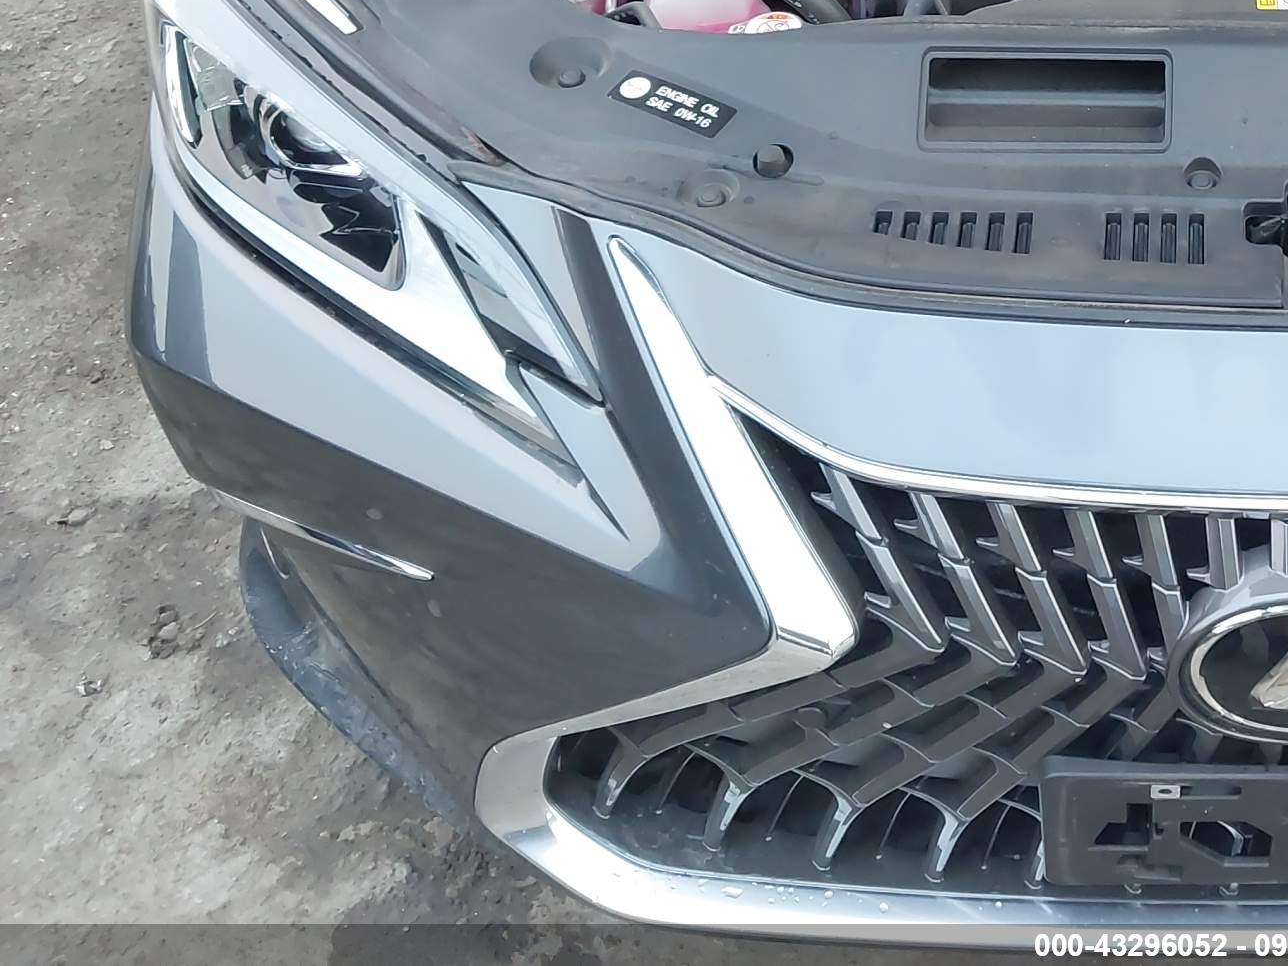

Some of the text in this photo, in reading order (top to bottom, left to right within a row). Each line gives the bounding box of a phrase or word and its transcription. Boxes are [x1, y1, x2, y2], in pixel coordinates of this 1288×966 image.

[645, 96, 712, 128] SAE 0W-16
[655, 85, 719, 118] ENGINE OIL
